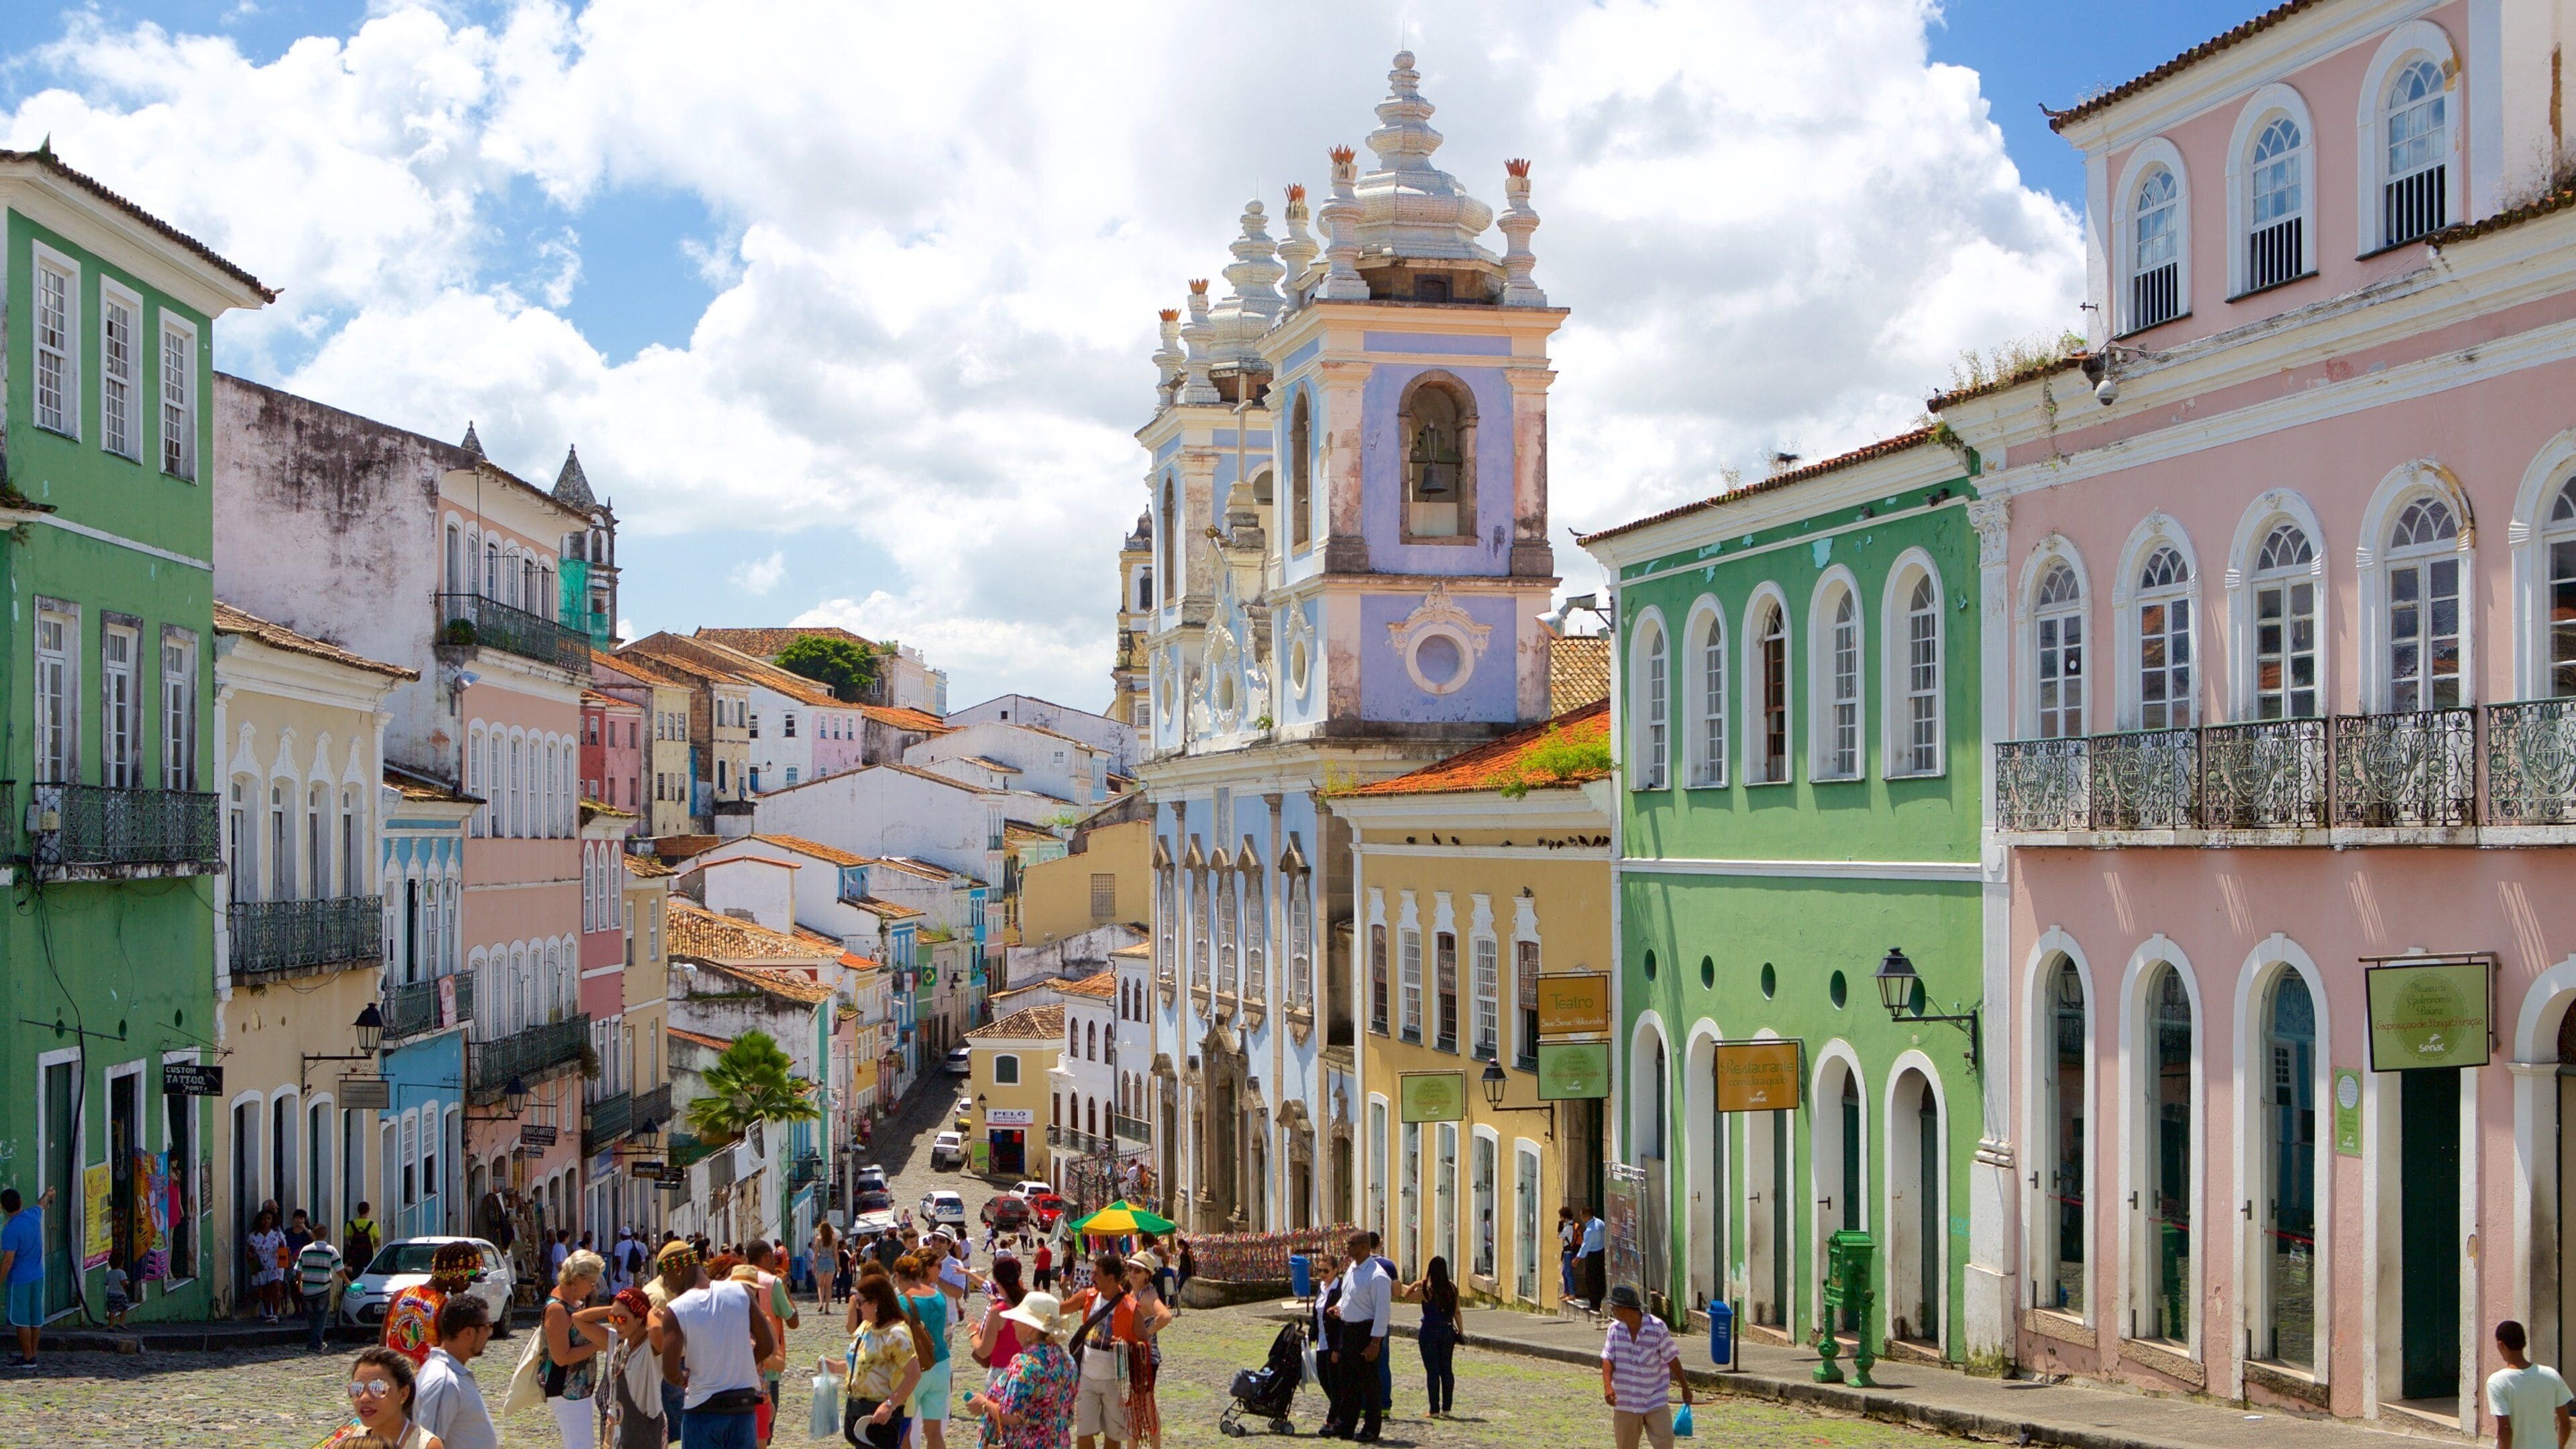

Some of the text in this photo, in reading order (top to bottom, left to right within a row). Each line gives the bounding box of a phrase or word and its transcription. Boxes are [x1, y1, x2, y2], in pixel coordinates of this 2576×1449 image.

[2410, 981, 2447, 992] Museu da
[1549, 993, 1594, 1010] Teatro
[2406, 994, 2452, 1009] Gastronomia
[2416, 1008, 2443, 1016] Baiana
[2375, 1015, 2483, 1034] Exposição de Longa Duração
[1720, 1059, 1794, 1074] Restaurante
[166, 1075, 205, 1084] TATTOO
[1728, 1075, 1758, 1086] comida
[539, 1128, 555, 1136] ARTES
